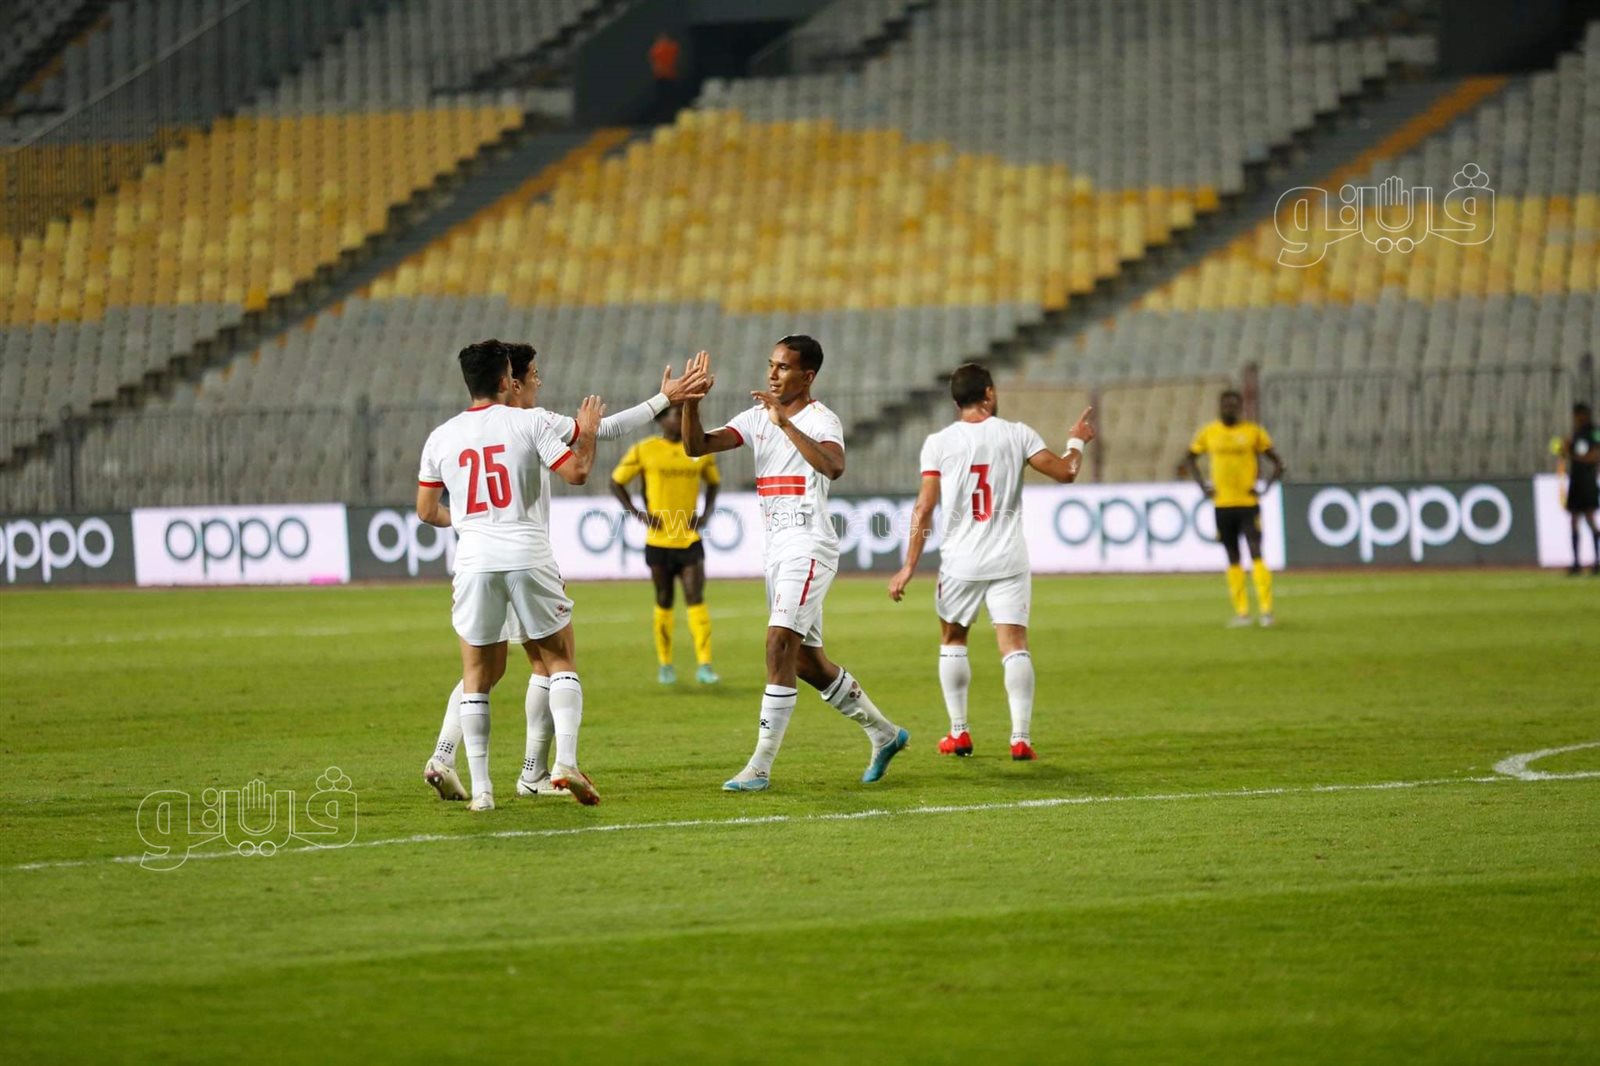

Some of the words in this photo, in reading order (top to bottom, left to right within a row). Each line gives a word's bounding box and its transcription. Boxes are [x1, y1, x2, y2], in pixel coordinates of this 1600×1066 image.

[458, 444, 512, 515] 25
[970, 464, 992, 523] 3
[0, 517, 114, 583] ppo
[165, 516, 309, 575] oppo
[367, 509, 456, 577] op
[578, 507, 744, 571] opo
[1308, 484, 1513, 563] oppo
